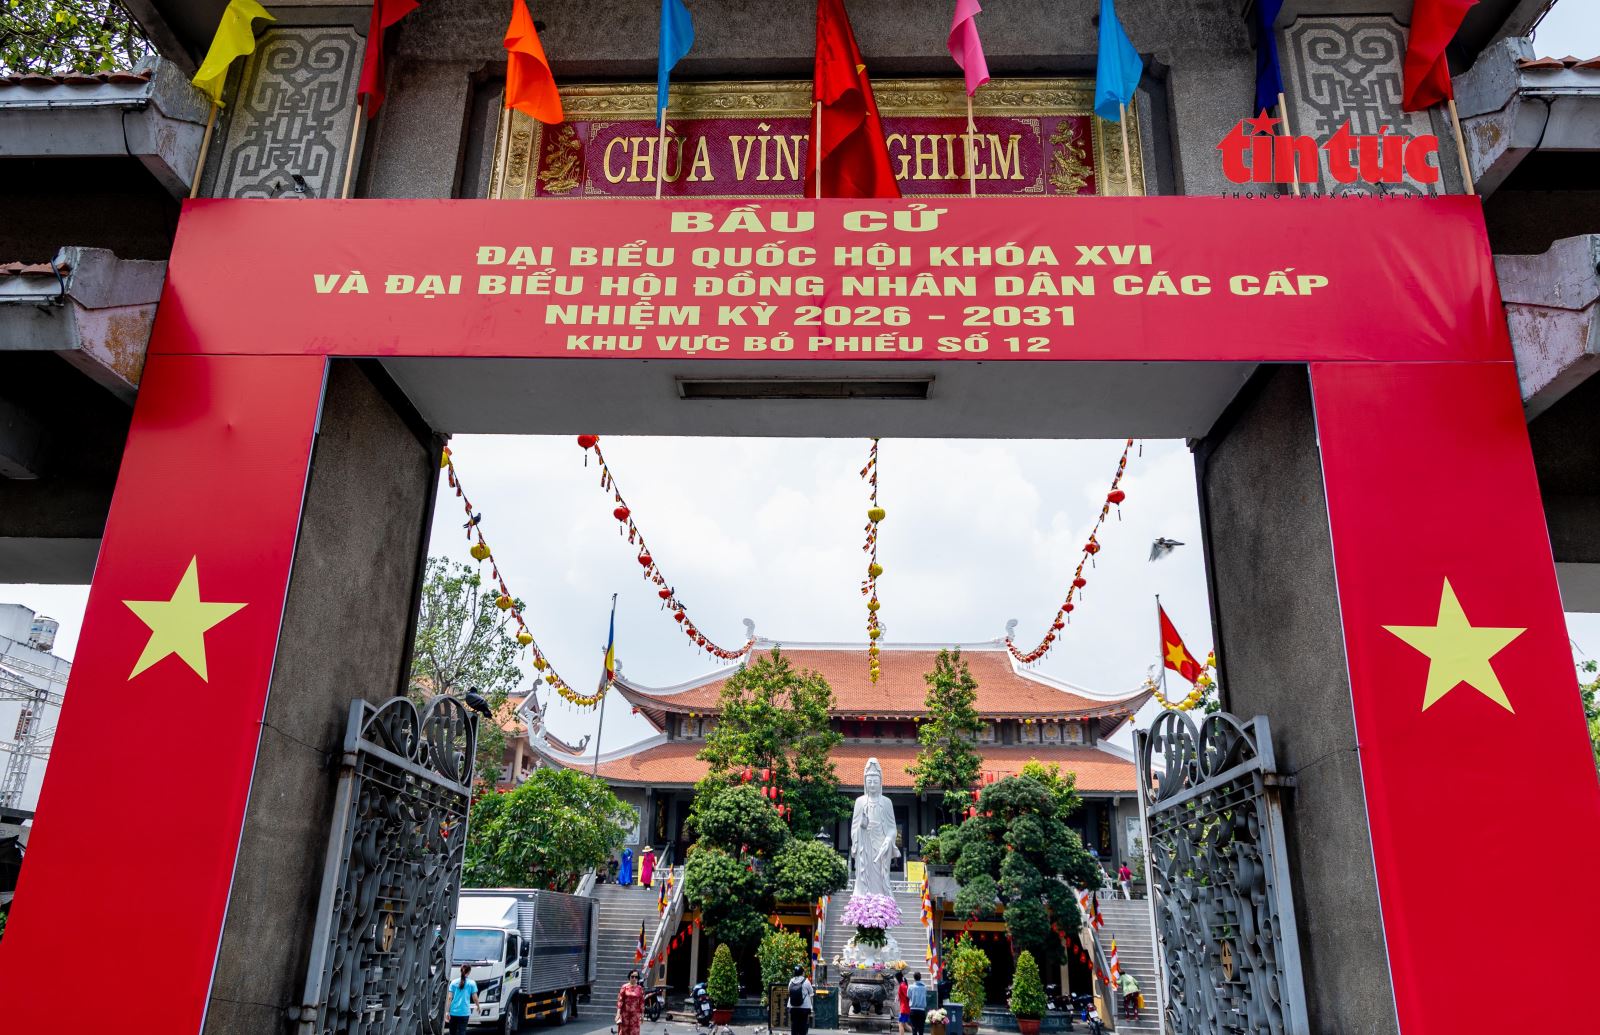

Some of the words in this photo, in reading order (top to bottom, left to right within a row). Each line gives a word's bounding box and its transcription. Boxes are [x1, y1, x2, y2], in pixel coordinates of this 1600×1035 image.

[603, 124, 715, 184] CHÙA
[729, 122, 808, 181] VĨN
[885, 119, 1024, 180] GHIÊM
[670, 204, 815, 233] BẦU
[843, 203, 948, 232] CỬ
[476, 245, 554, 270] ĐẠI
[569, 239, 675, 267] BIỂU
[691, 240, 817, 269] QUỐC
[834, 242, 912, 271] HỘI
[929, 241, 1060, 267] KHÓA
[1074, 244, 1153, 266] XVI
[313, 270, 370, 295] VÀ
[384, 274, 463, 299] ĐẠI
[477, 267, 584, 296] BIỂU
[599, 272, 678, 301] HỘI
[692, 270, 825, 297] ĐỒNG
[842, 272, 977, 297] NHÂN
[994, 271, 1096, 297] DÂN
[1112, 270, 1212, 297] CÁC
[1229, 267, 1329, 296] CẤP
[544, 301, 701, 330] NHIỆM
[717, 301, 779, 326] KỲ
[793, 305, 911, 327] 2026
[962, 305, 1075, 327] 2031
[566, 335, 643, 351] KHU
[655, 334, 730, 355] VỰC
[743, 331, 795, 352] BỎ
[808, 332, 923, 353] PHIẾU
[937, 331, 989, 353] SỐ
[1003, 337, 1051, 353] 12
